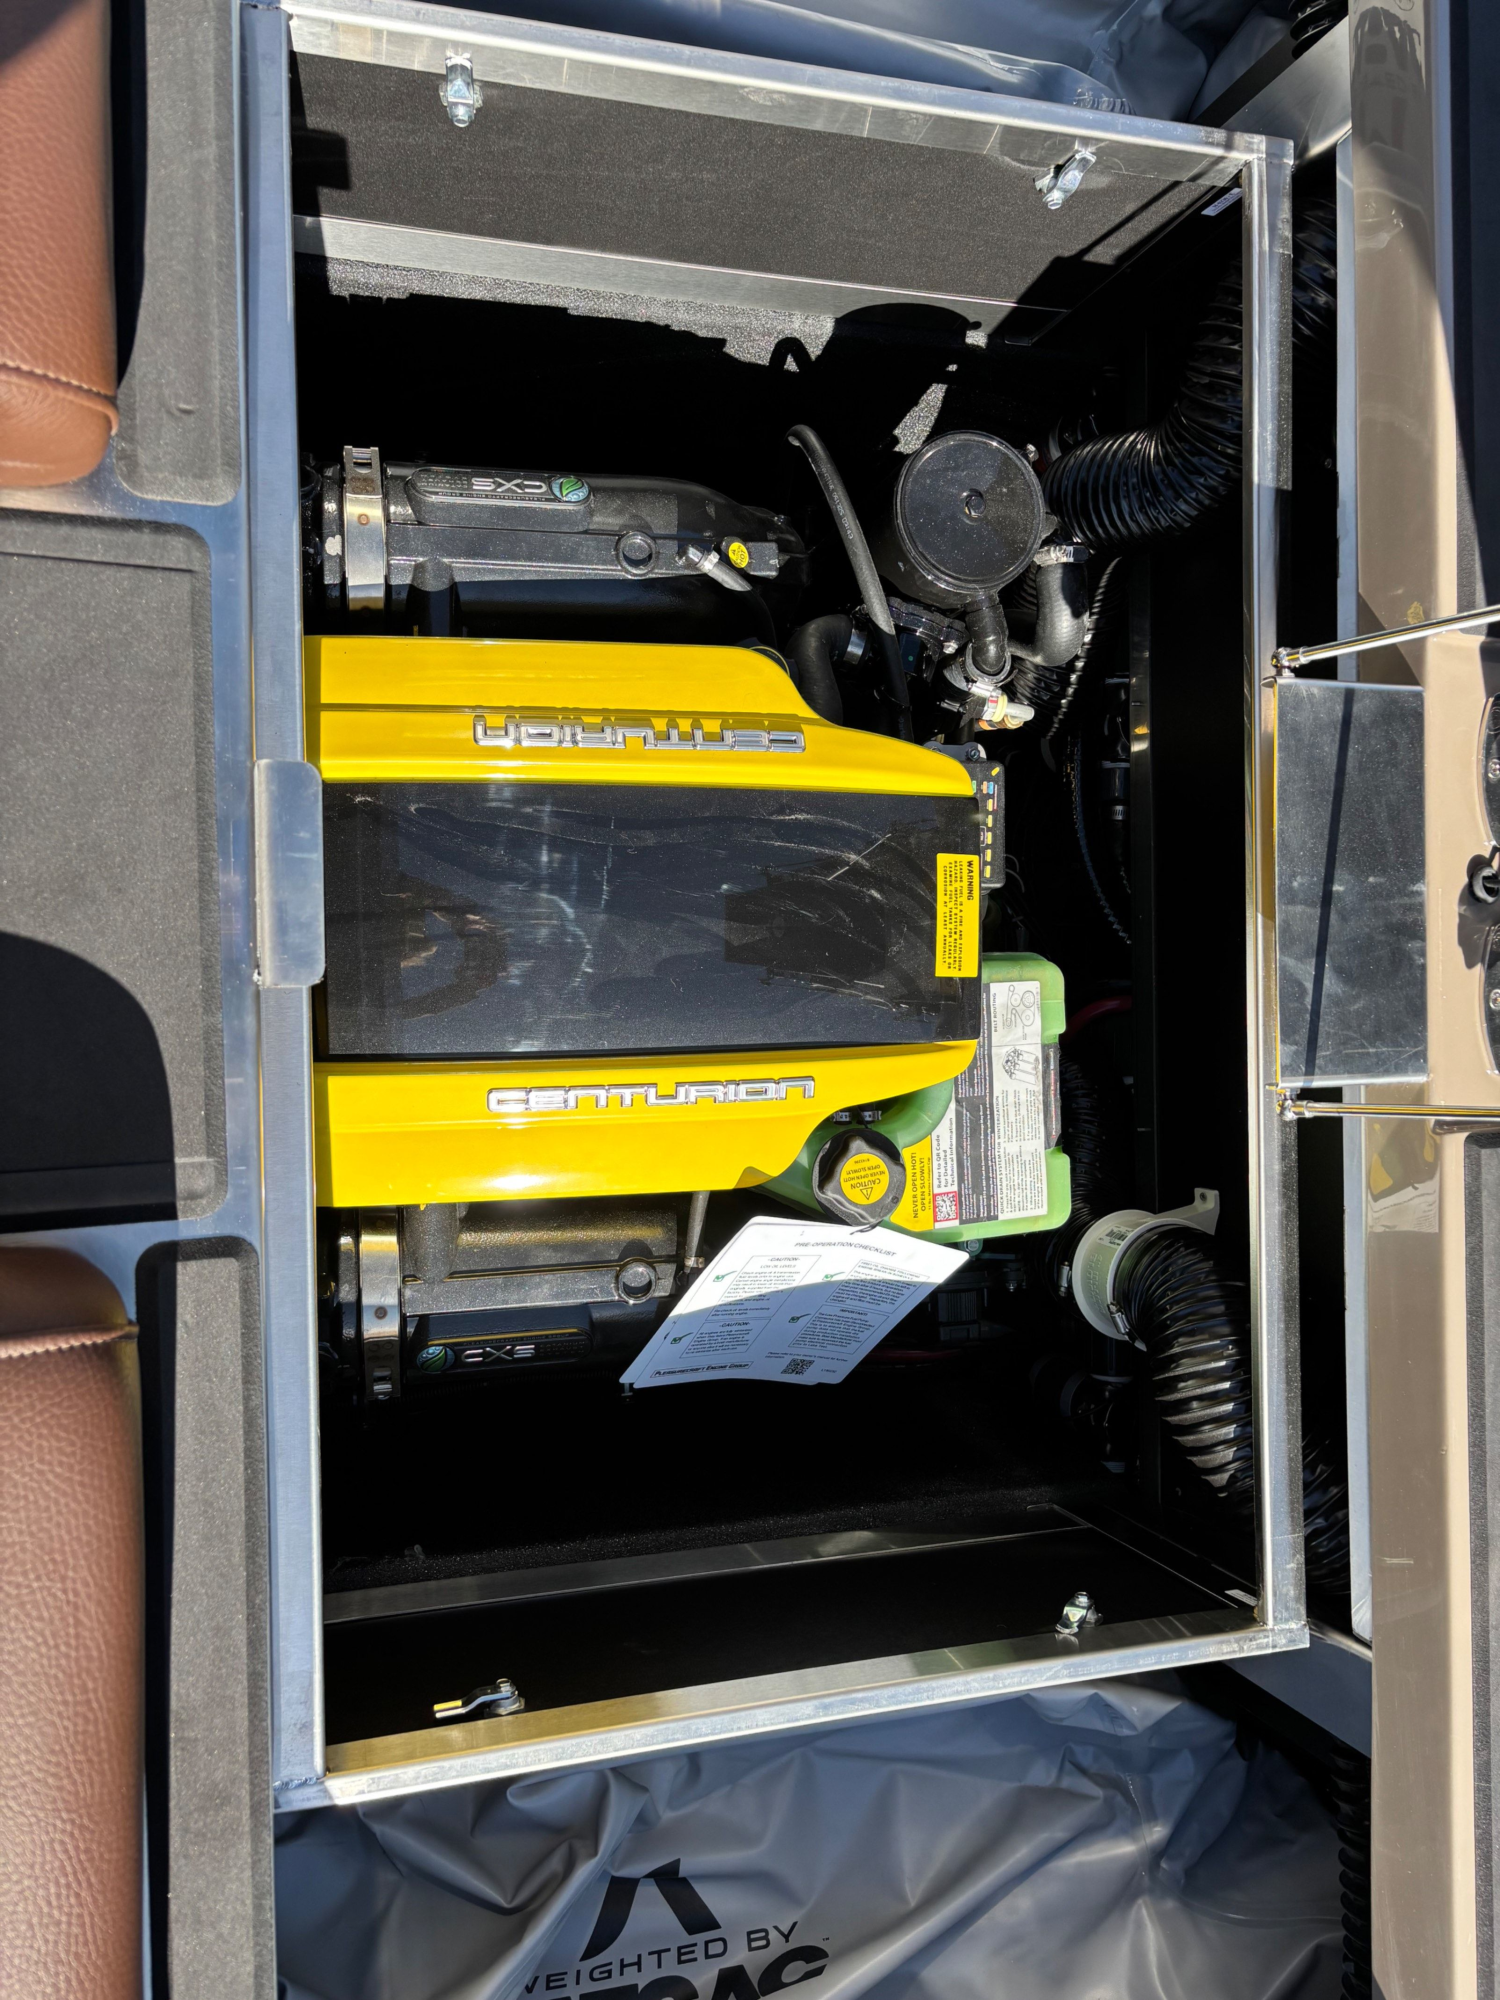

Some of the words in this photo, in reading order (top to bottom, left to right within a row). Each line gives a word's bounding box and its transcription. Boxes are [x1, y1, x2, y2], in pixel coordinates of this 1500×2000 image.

[471, 477, 547, 493] CXS
[473, 720, 806, 753] CENTURION
[486, 1075, 815, 1113] CENTURION
[936, 1152, 941, 1161] QR
[846, 1167, 866, 1175] SLOWLY!
[850, 1178, 881, 1189] CAUTION
[854, 1243, 897, 1258] CHECKLIST
[461, 1344, 536, 1363] CXS
[705, 1364, 729, 1372] ENGINE
[728, 1362, 749, 1370] GROUP
[746, 1920, 799, 1952] BY
